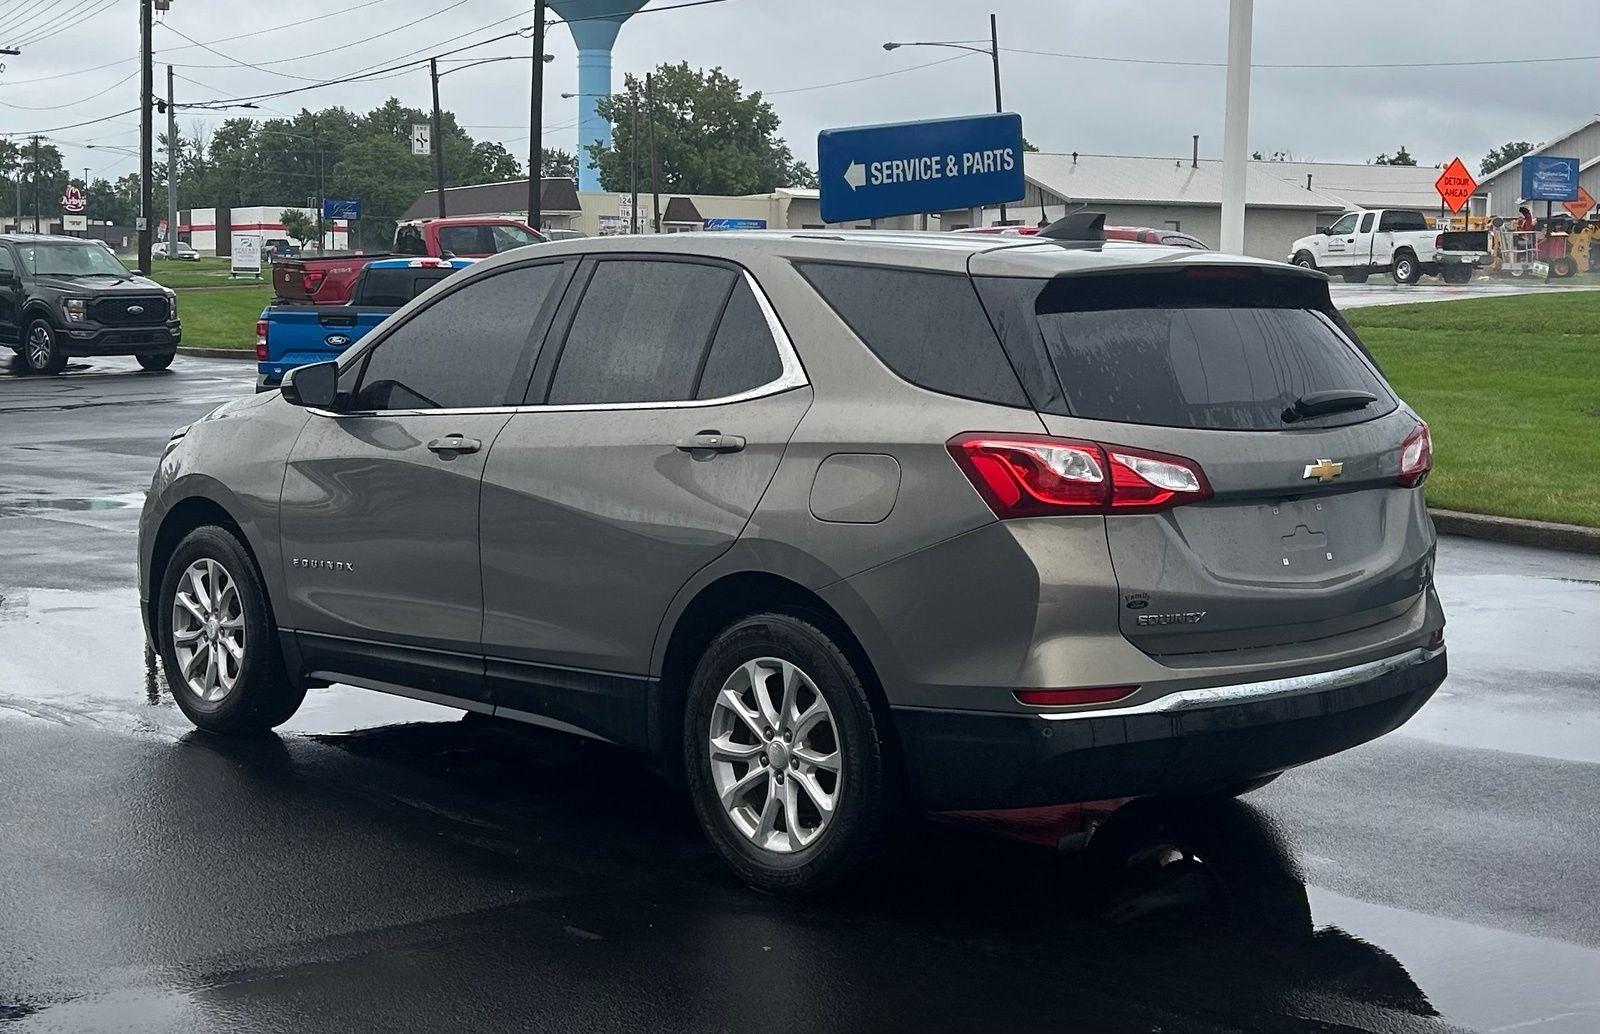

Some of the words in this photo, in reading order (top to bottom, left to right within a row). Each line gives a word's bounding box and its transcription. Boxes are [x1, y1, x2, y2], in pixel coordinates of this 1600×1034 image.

[870, 156, 942, 186] SERVICE
[945, 154, 959, 177] &
[962, 147, 1015, 176] PARTS
[1444, 177, 1470, 186] DETOUR
[1444, 188, 1469, 197] AHEAD
[292, 558, 354, 571] EQUINOX
